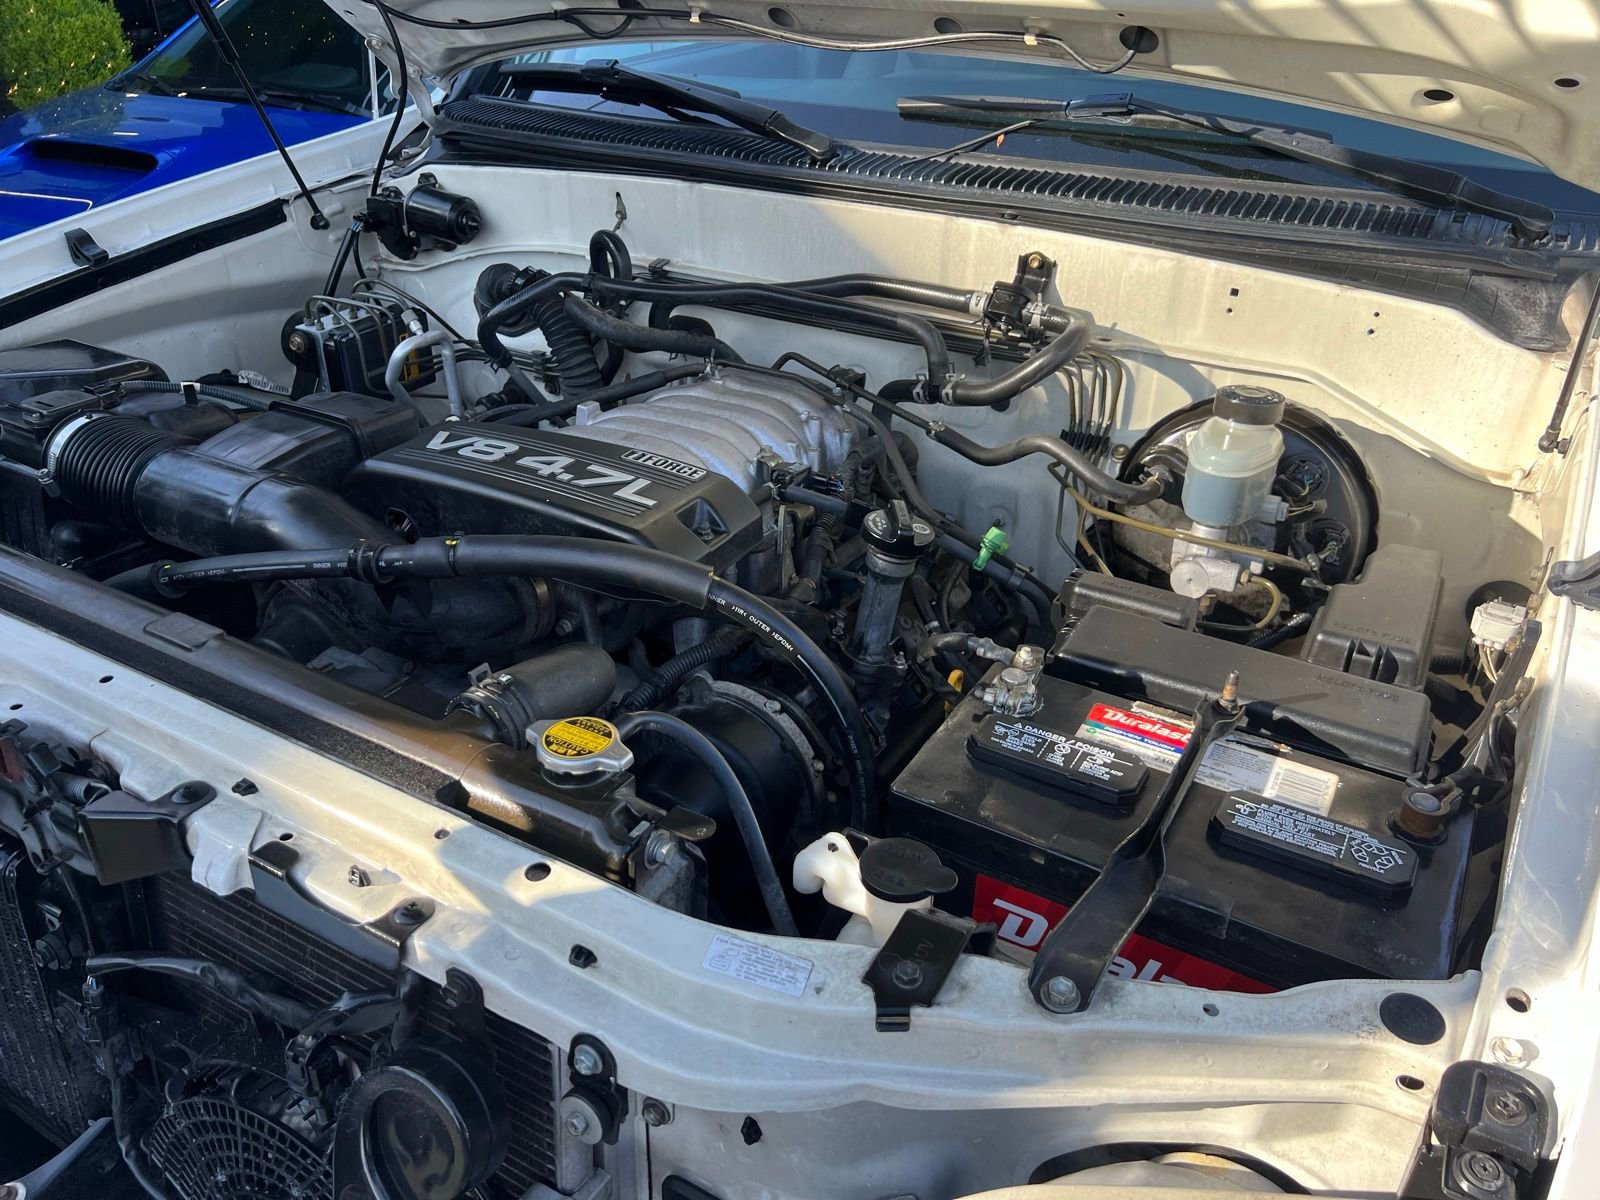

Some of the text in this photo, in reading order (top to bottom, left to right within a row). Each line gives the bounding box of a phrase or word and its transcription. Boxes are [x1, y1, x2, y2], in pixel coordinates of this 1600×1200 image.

[426, 430, 658, 507] V8 4.7L
[748, 615, 771, 633] OUTER
[546, 736, 589, 754] CAUTION
[1024, 725, 1067, 743] DANGER
[1075, 741, 1115, 758] POISON
[1103, 726, 1142, 740] PROVEN
[1142, 737, 1176, 751] TOUGH
[1295, 820, 1335, 836] IMMEDIATELY
